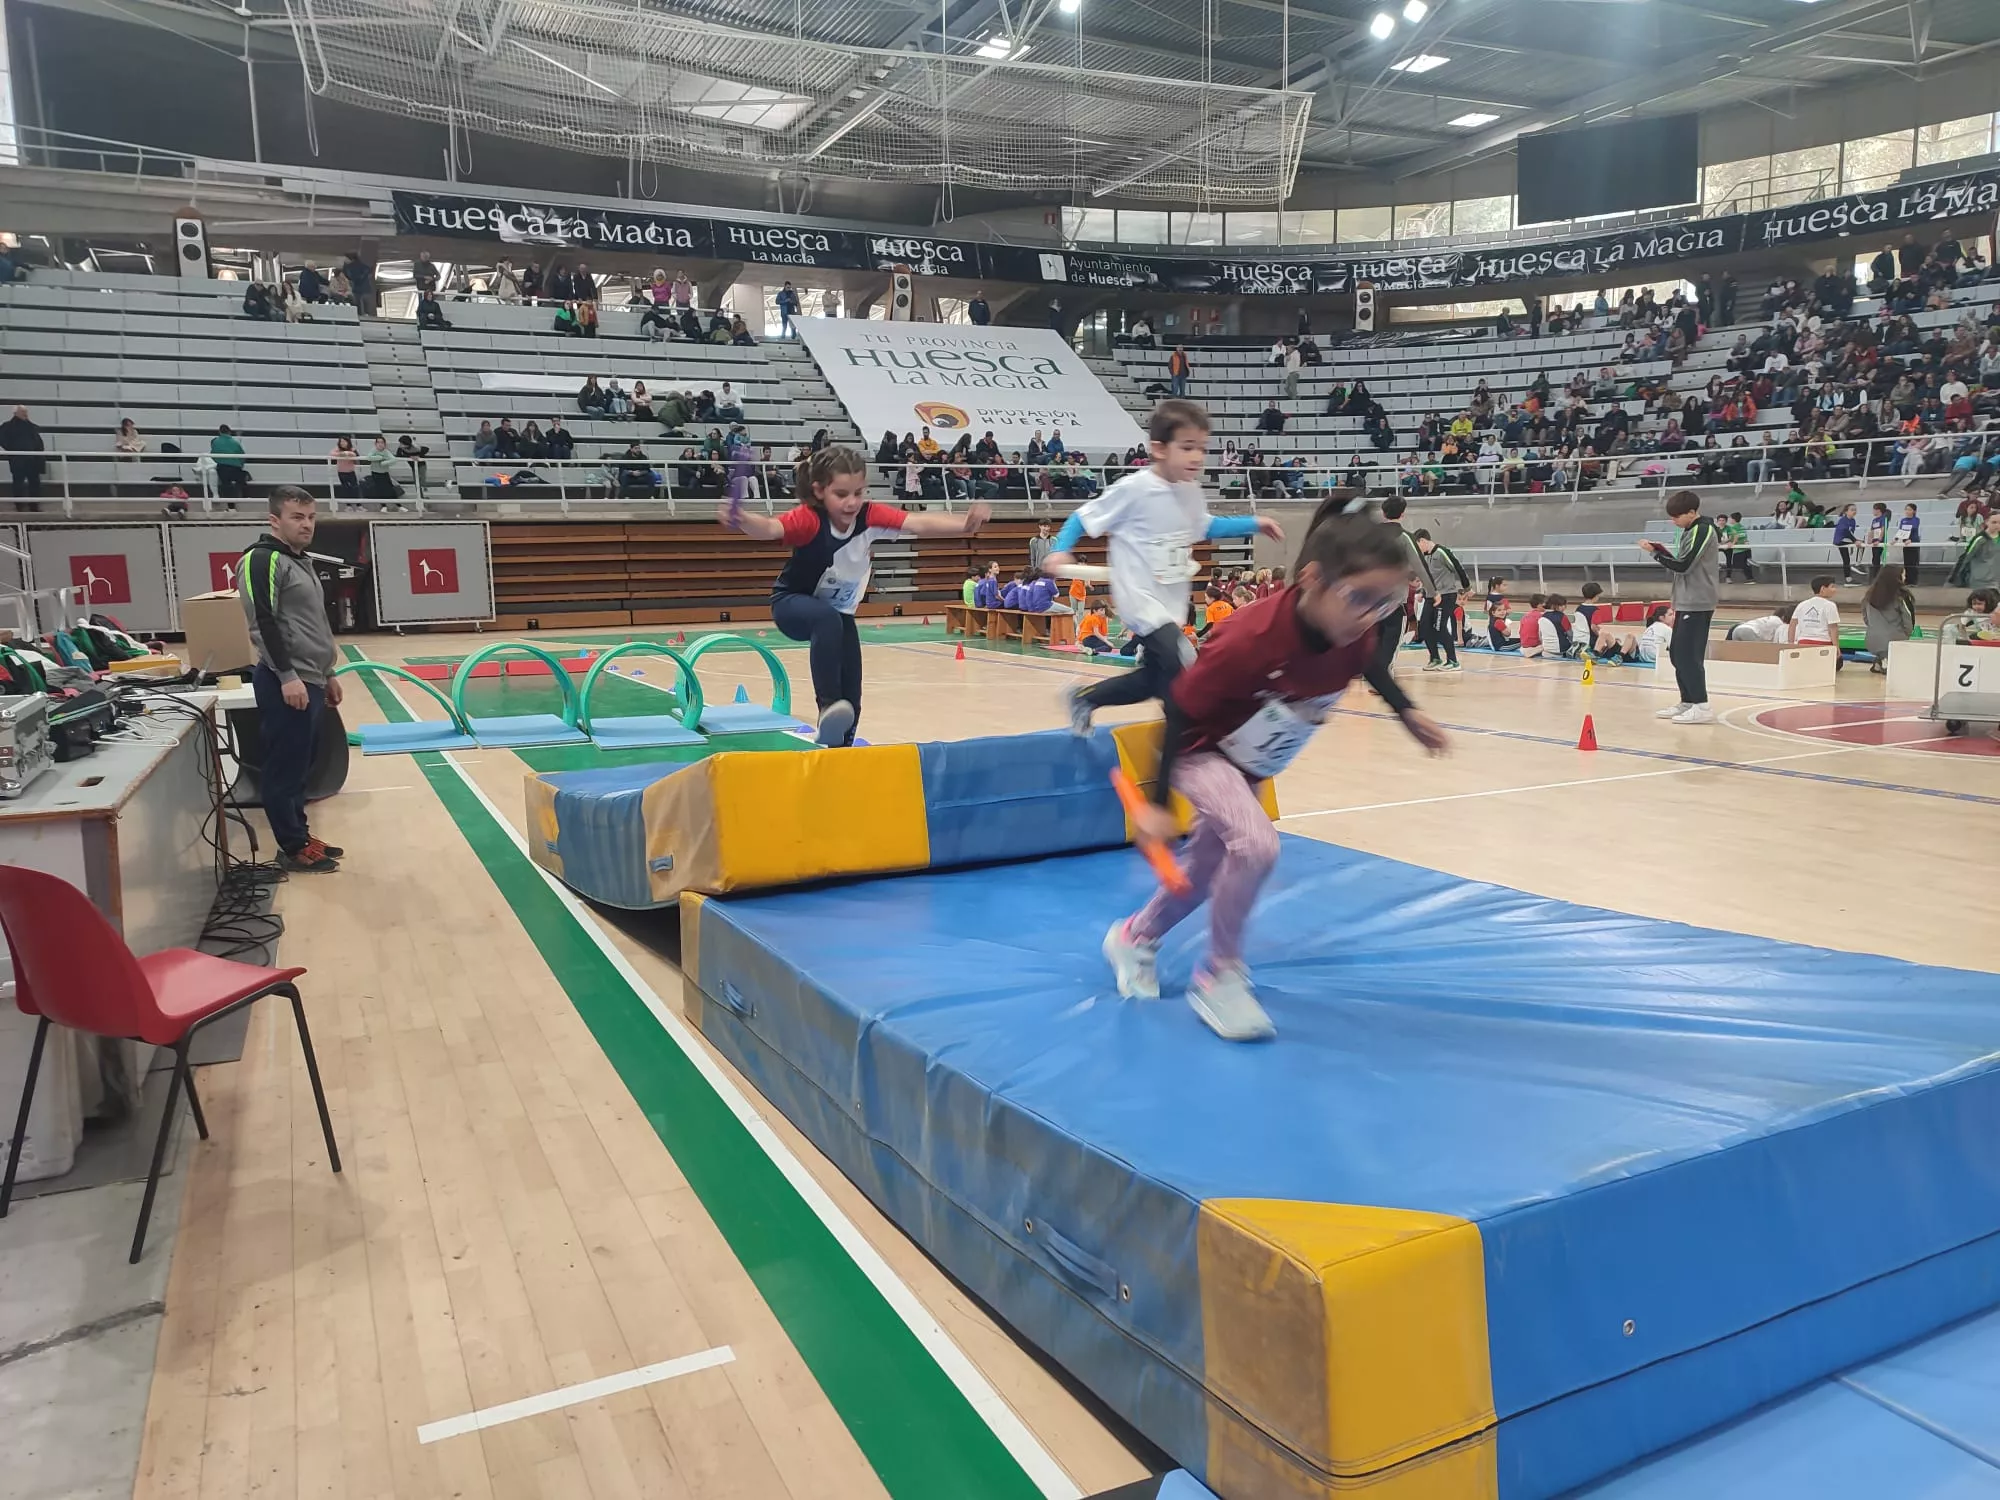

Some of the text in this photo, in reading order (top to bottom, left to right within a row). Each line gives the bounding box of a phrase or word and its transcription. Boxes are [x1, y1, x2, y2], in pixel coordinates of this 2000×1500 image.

[1070, 255, 1151, 274] Ayuntamiento
[1071, 272, 1134, 287] de Huesca
[981, 417, 1083, 427] HUESCA
[1582, 669, 1590, 681] 0
[1958, 664, 1974, 687] 2
